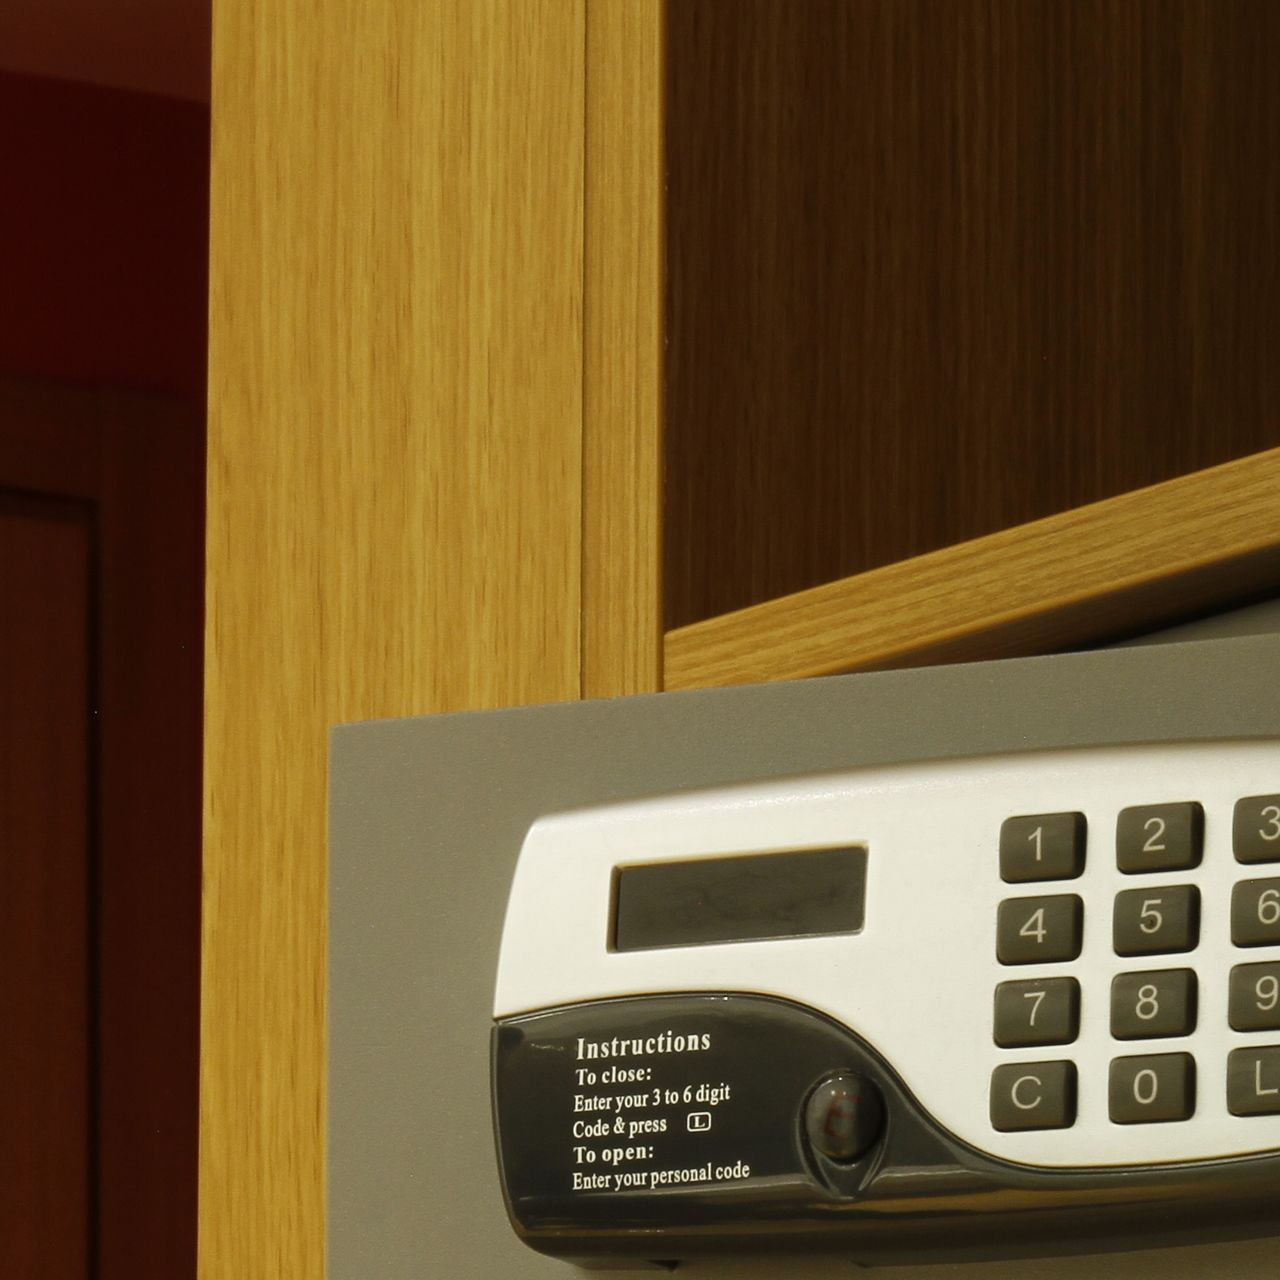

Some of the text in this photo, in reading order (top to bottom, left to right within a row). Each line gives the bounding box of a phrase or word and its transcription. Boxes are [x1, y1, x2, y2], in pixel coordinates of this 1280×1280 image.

[1027, 827, 1042, 861] 1
[1142, 818, 1166, 852] 2
[1139, 899, 1163, 933] 5
[1257, 889, 1280, 924] 6
[1020, 908, 1047, 943] 4
[1023, 991, 1046, 1026] 7
[1135, 985, 1159, 1019] 8
[1256, 976, 1279, 1010] 9
[576, 1030, 710, 1060] Instructions
[576, 1066, 651, 1085] To close:
[1011, 1076, 1041, 1109] C
[1133, 1070, 1158, 1104] 0
[1255, 1060, 1278, 1096] L
[574, 1083, 730, 1113] Enter your 3 to 6 digit
[573, 1116, 705, 1138] Code & press L
[573, 1146, 653, 1165] To open:
[572, 1161, 750, 1191] Enter your personal code
